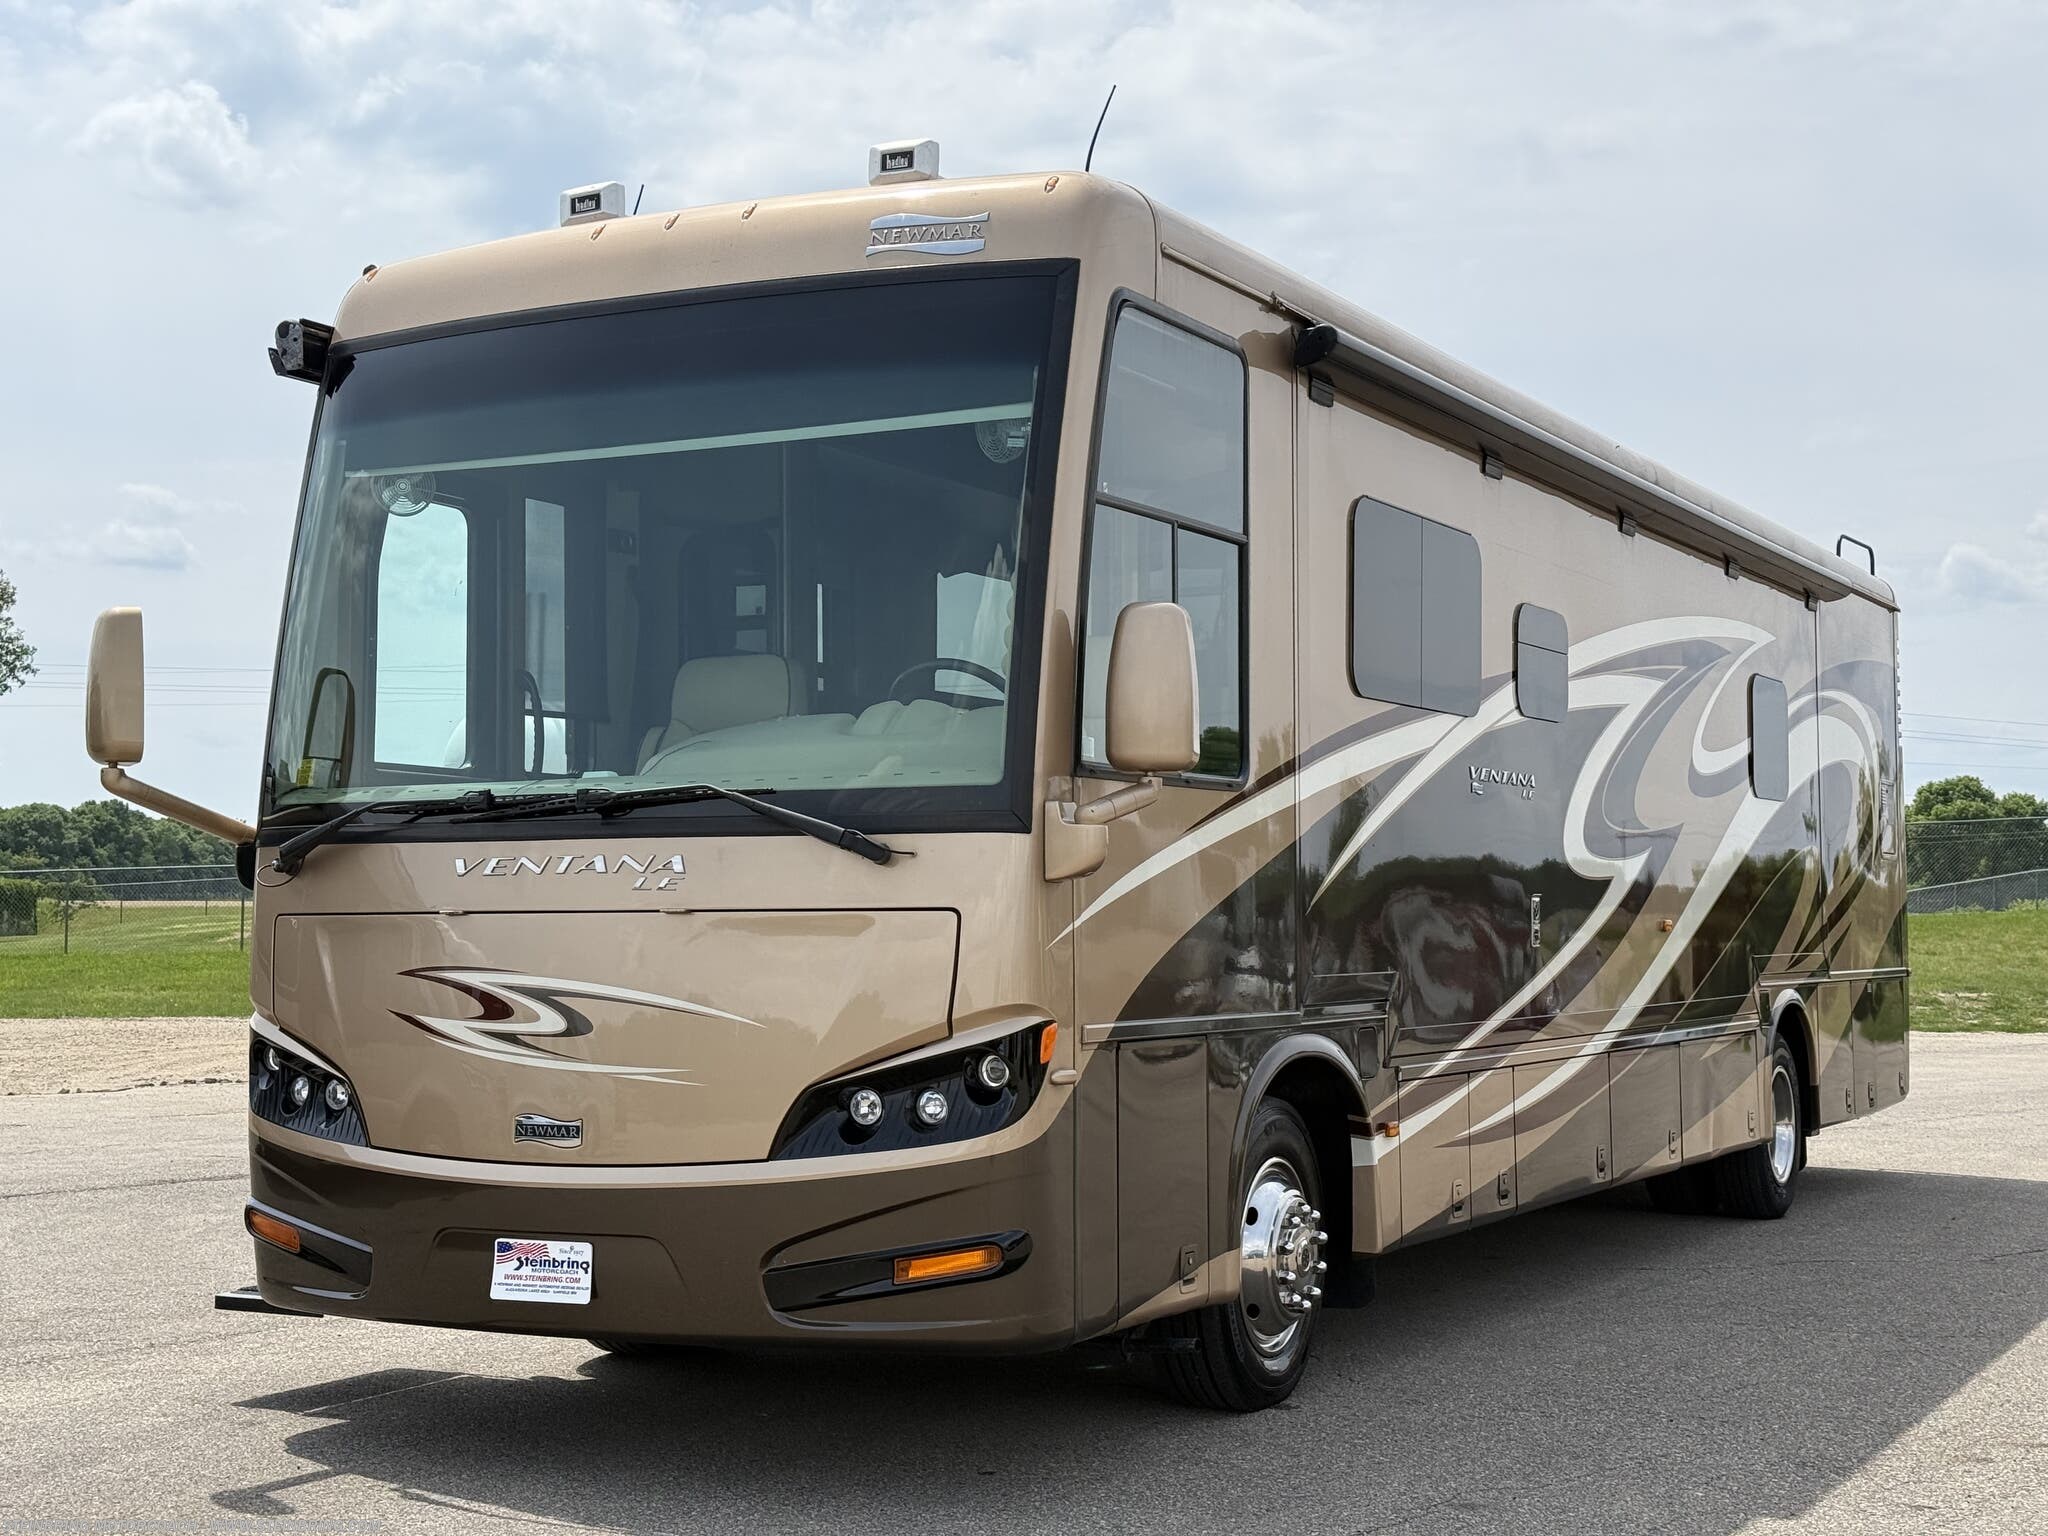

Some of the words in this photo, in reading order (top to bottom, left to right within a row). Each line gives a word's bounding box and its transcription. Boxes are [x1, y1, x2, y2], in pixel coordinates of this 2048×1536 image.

[886, 155, 909, 170] hadley
[575, 198, 596, 212] hadley
[870, 223, 985, 246] NEWMAR
[1468, 765, 1536, 788] VENTANA
[454, 854, 687, 877] VENTANA
[631, 876, 686, 891] LE
[516, 1125, 579, 1137] NEWMAR
[513, 1256, 590, 1275] Steinbring
[503, 1273, 581, 1284] WWW.STEINBRING.COM
